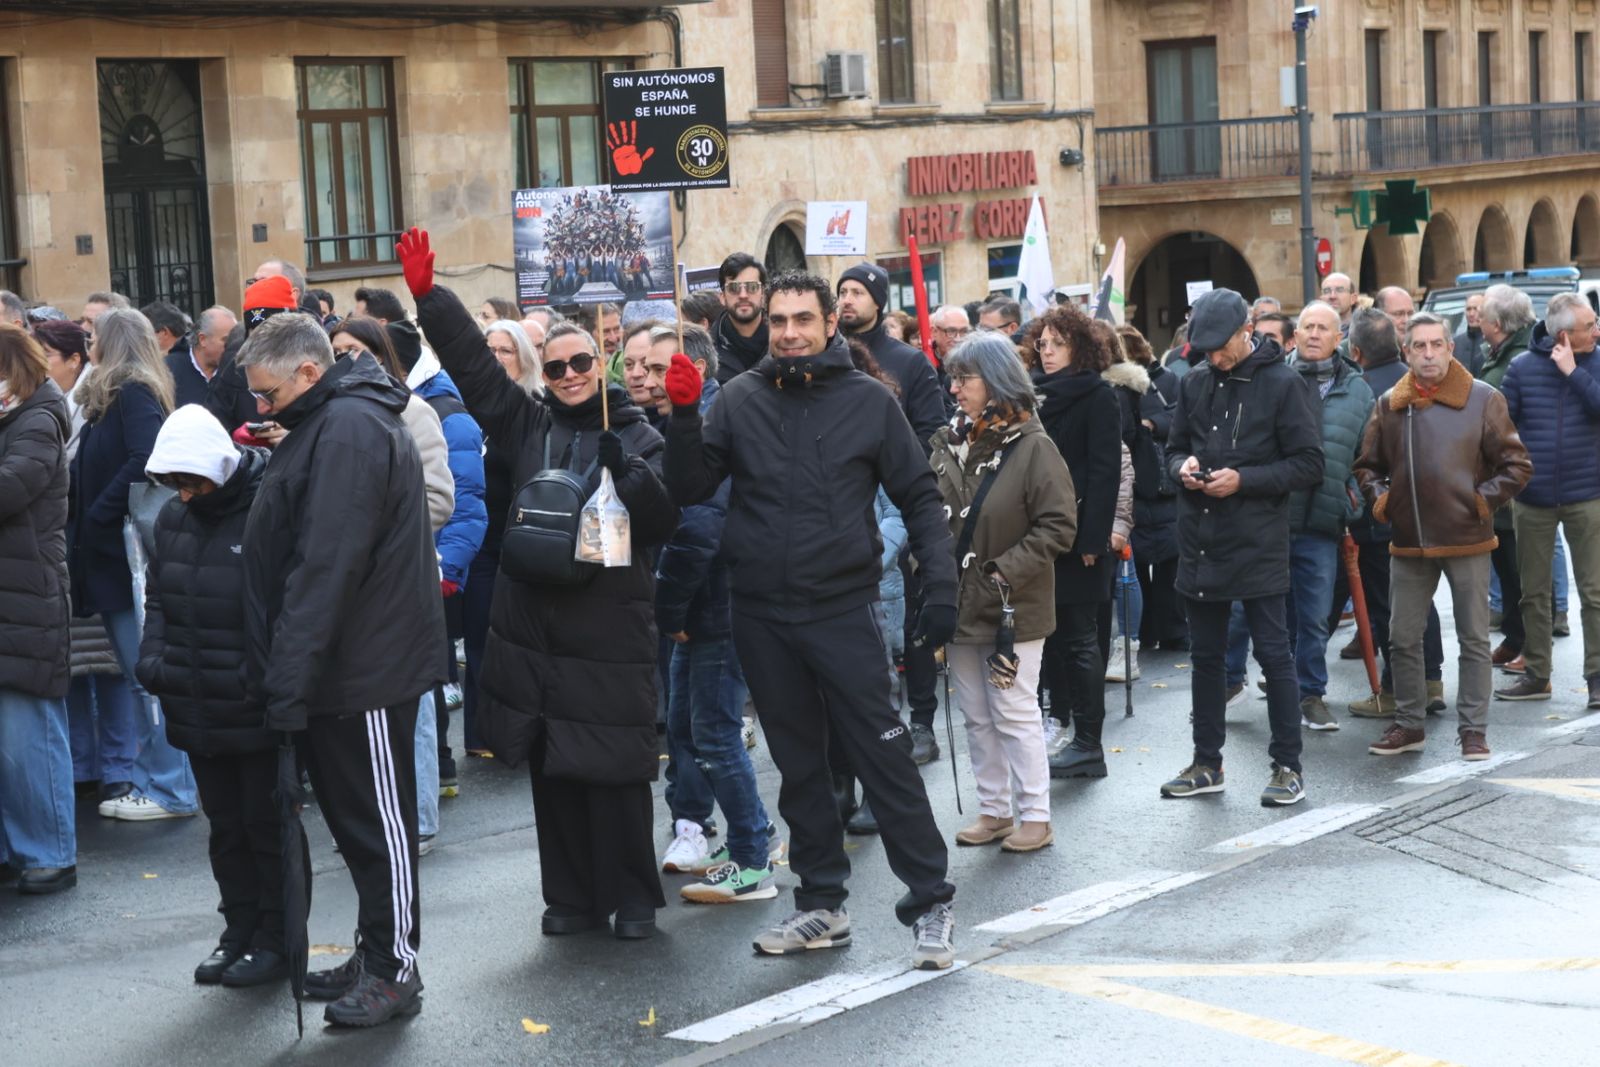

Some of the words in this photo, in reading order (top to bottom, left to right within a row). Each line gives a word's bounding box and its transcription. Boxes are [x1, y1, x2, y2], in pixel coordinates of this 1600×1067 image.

[613, 77, 633, 88] SIN
[637, 72, 716, 87] AUTÓNOMOS
[641, 88, 689, 101] ESPAÑA
[635, 107, 650, 117] SE
[654, 104, 697, 116] HUNDE
[690, 138, 713, 157] 30
[698, 157, 707, 167] N
[907, 150, 1038, 196] INMOBILIARIA
[515, 190, 558, 201] Autono
[516, 199, 541, 209] mos
[899, 203, 966, 246] PEREZ
[973, 196, 1048, 240] CORR
